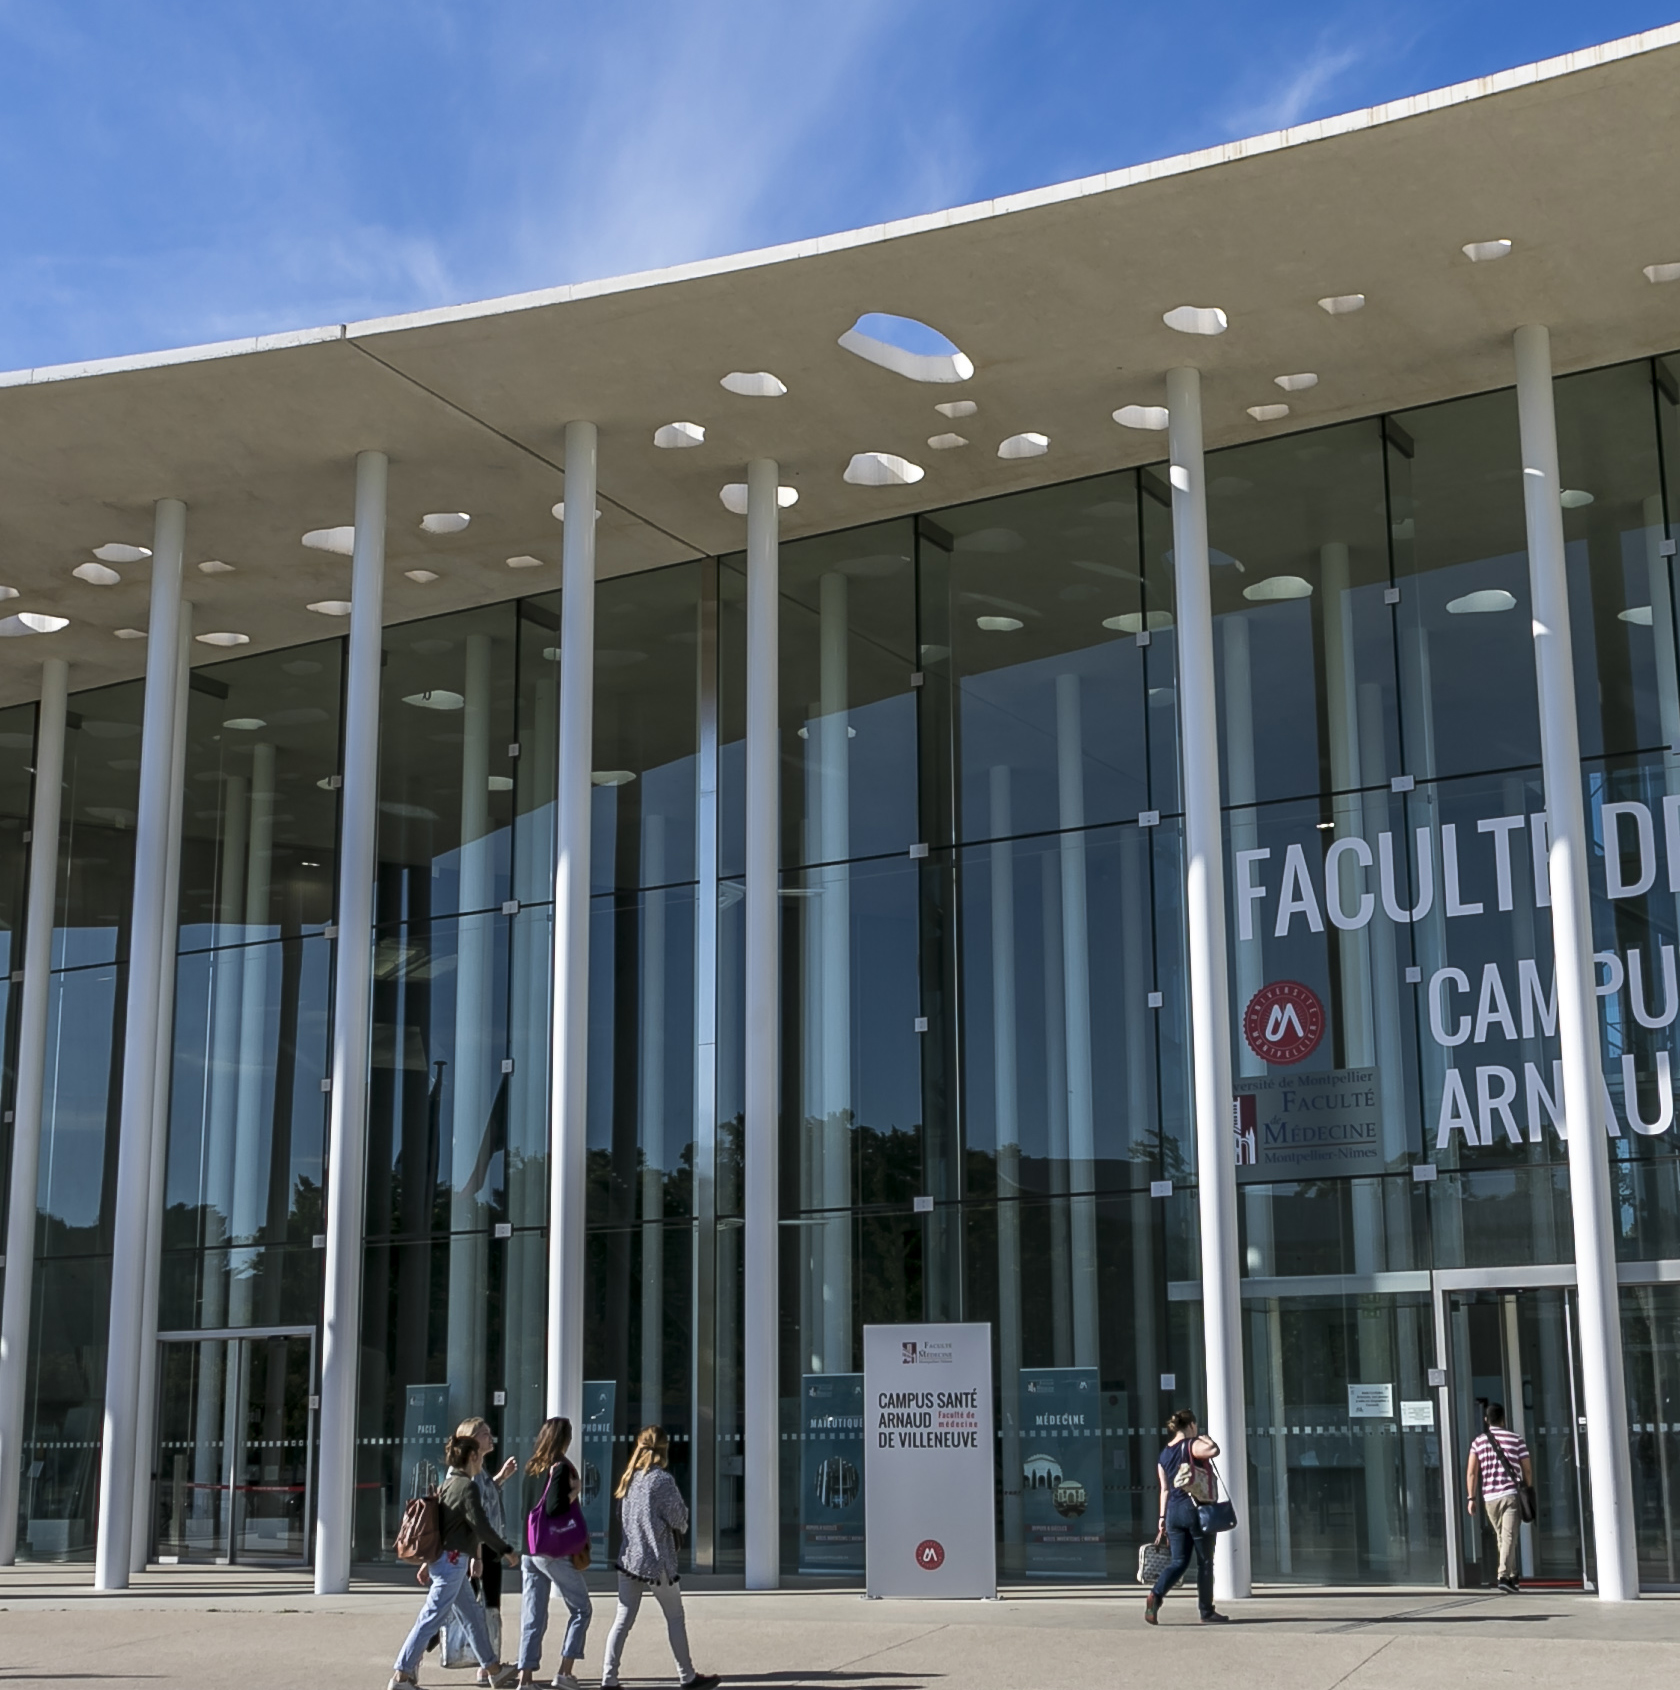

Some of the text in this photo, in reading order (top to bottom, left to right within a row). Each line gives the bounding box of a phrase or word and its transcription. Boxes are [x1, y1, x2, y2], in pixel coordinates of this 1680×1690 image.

[1233, 1071, 1373, 1092] versité de Montpellier
[1282, 1088, 1375, 1113] FACULTÉ
[1270, 1114, 1282, 1125] de
[1263, 1121, 1377, 1145] MÉDECINE
[878, 1388, 978, 1409] CAMPUS SANTÉ
[878, 1411, 932, 1429] ARNAUD
[938, 1410, 975, 1419] Faculté de
[1036, 1413, 1085, 1426] MÉDECINE
[417, 1424, 436, 1434] PACES
[582, 1422, 610, 1433] PHONIE
[938, 1419, 978, 1428] médecine
[878, 1431, 978, 1448] DE VILLENEUVE
